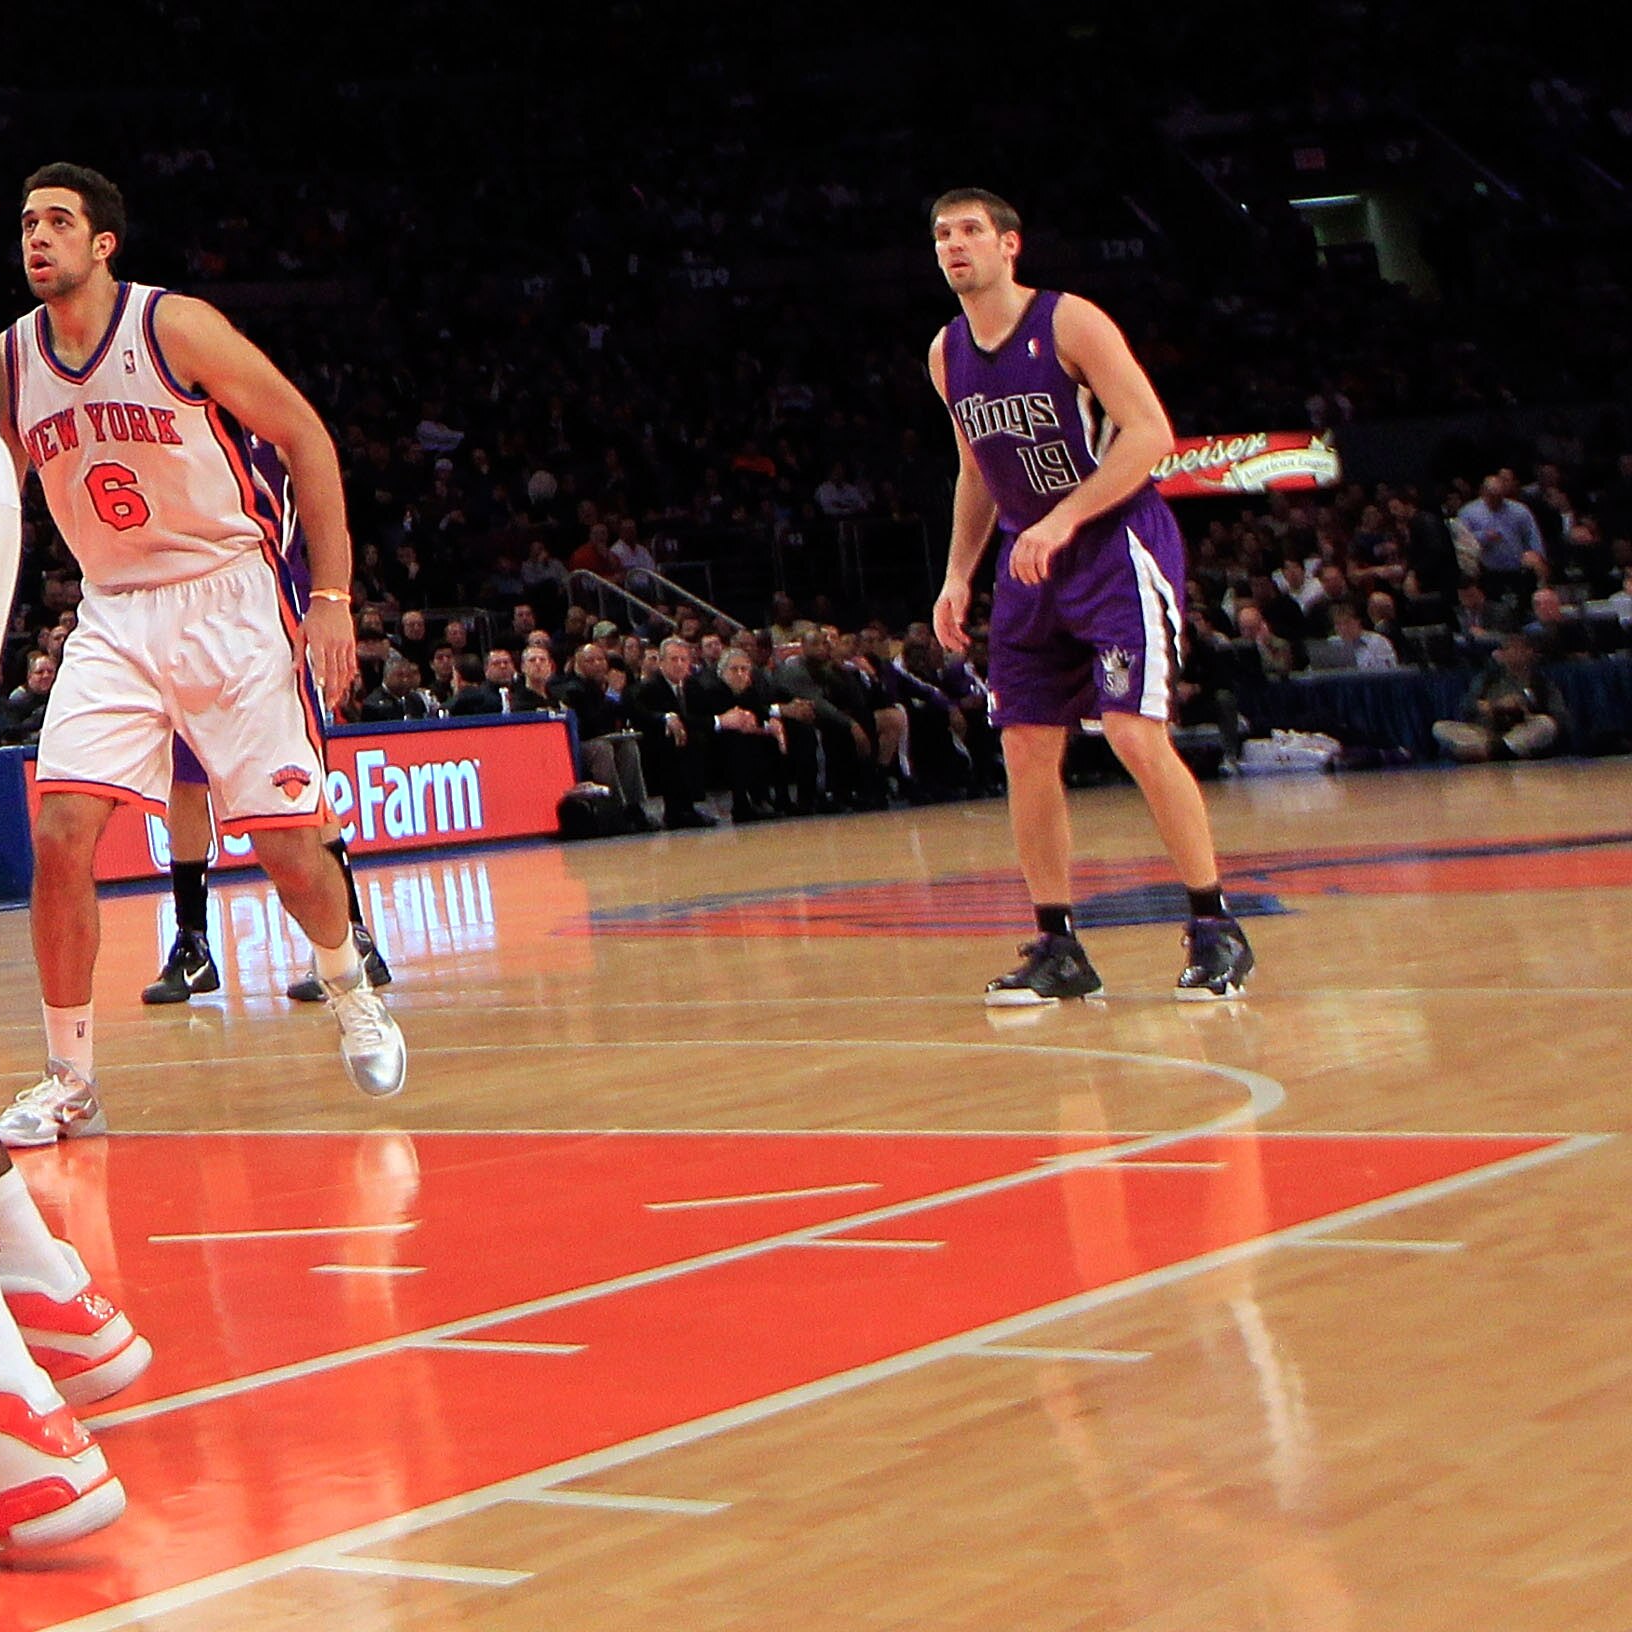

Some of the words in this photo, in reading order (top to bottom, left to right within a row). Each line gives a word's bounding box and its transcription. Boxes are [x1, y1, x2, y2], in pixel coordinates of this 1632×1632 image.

[24, 407, 80, 468] NEW
[83, 401, 183, 446] YORK
[955, 391, 1060, 443] Kings
[83, 461, 152, 532] 6
[1017, 439, 1082, 495] 19
